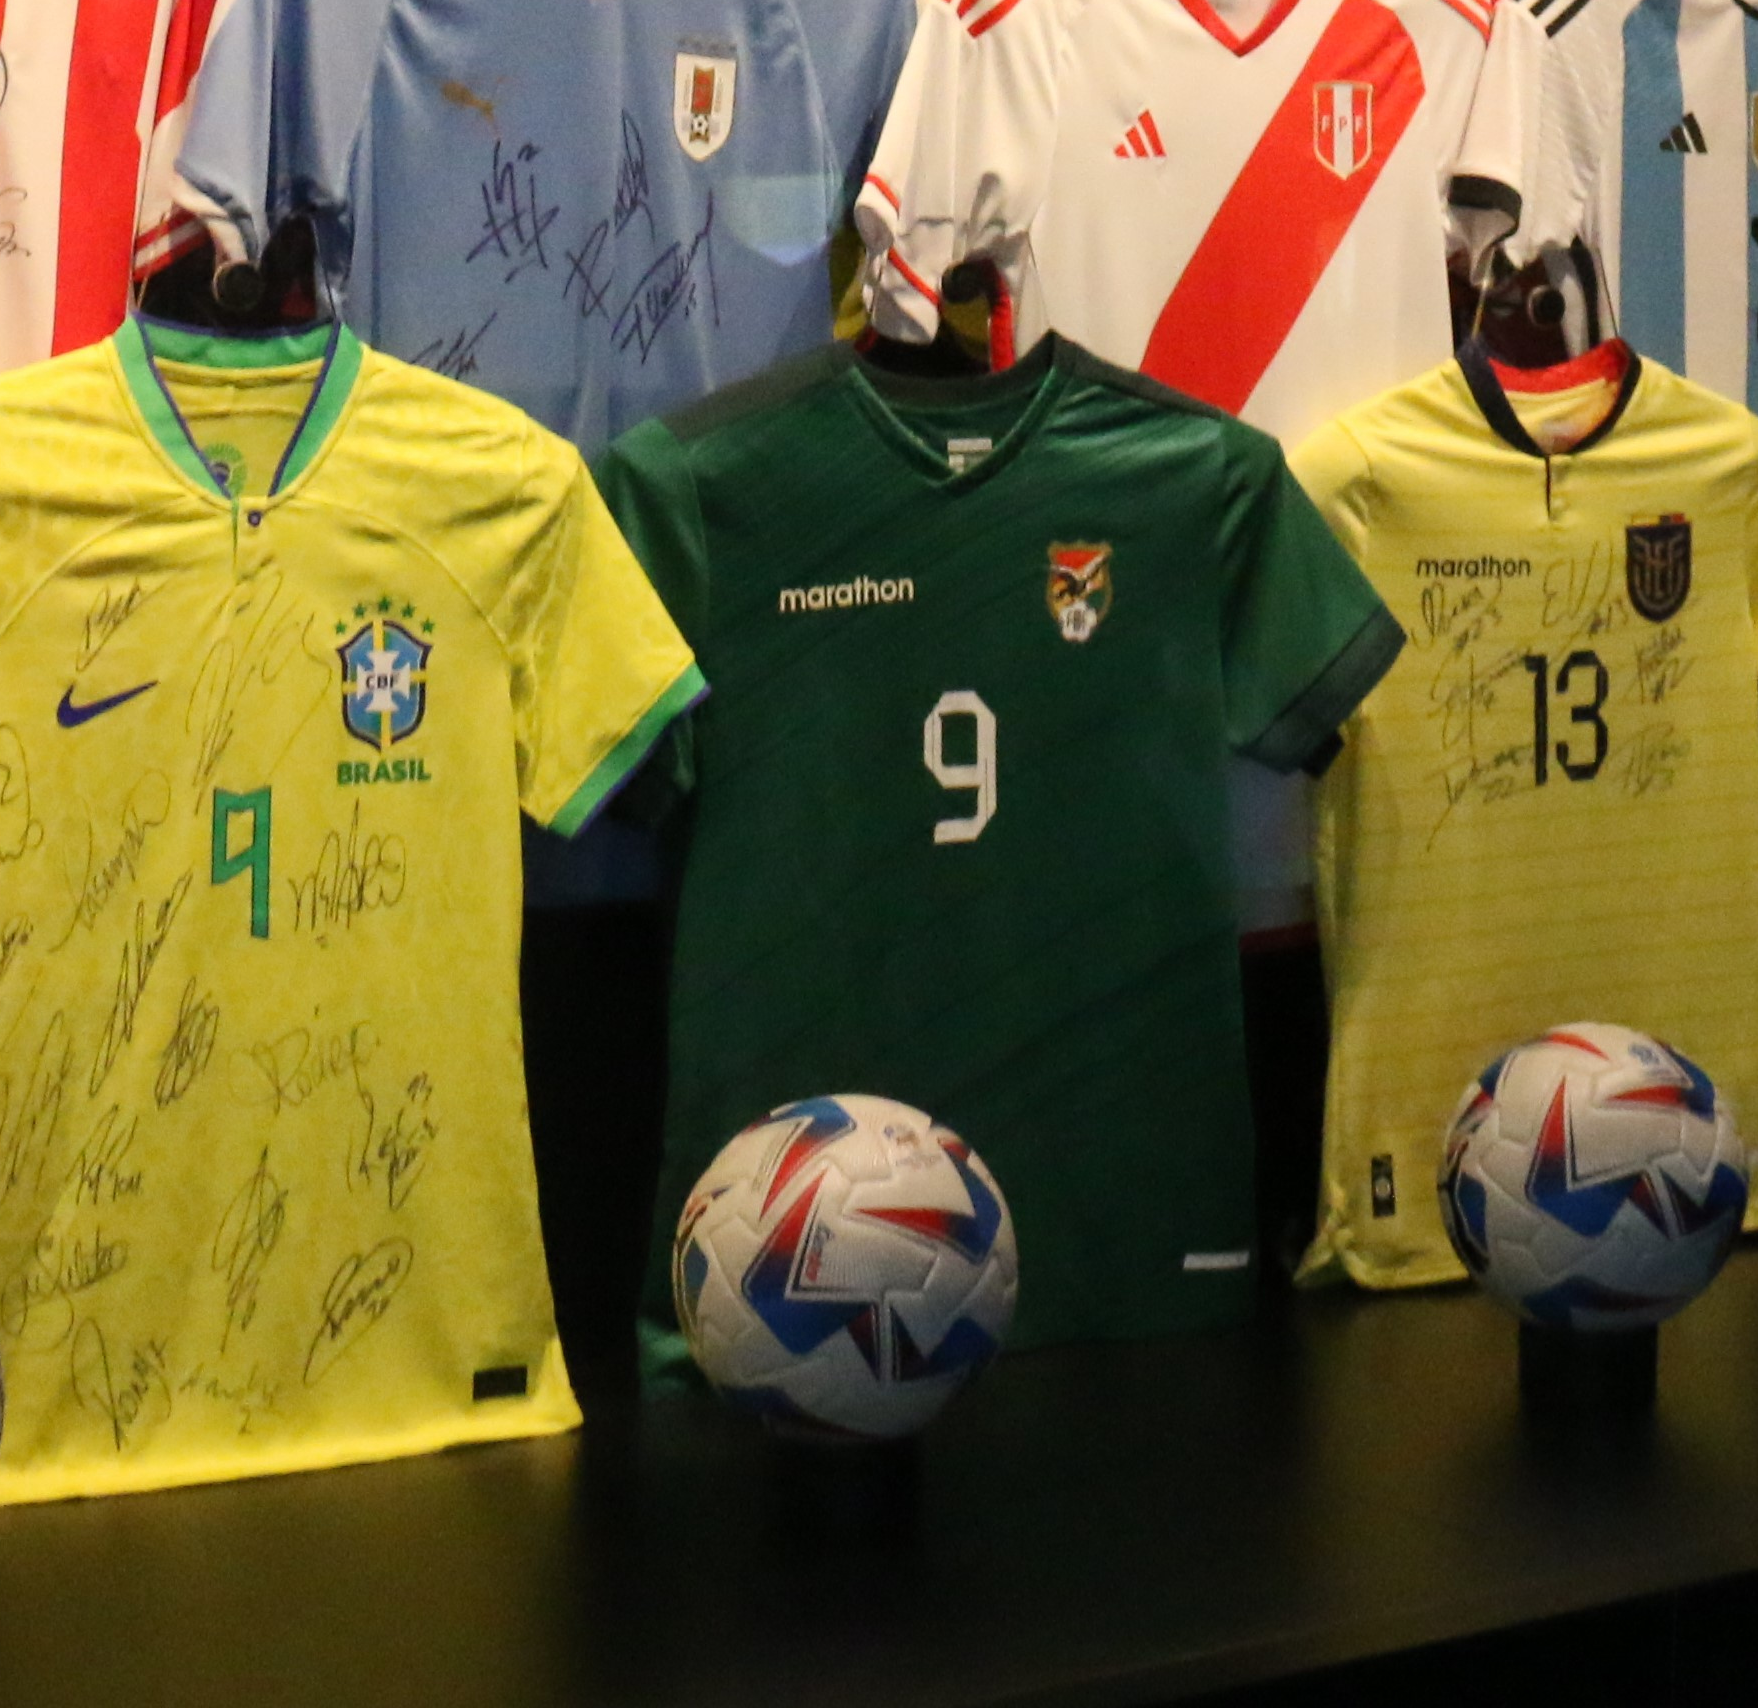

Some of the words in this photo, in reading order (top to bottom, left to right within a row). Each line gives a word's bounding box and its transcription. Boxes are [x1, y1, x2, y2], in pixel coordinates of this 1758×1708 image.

[1321, 115, 1364, 133] FPF
[1416, 556, 1531, 578] marathon
[779, 574, 914, 613] marathon
[366, 673, 399, 689] CBF
[1525, 649, 1609, 786] 13
[337, 759, 432, 785] BRASIL
[923, 690, 997, 844] 9
[212, 786, 272, 939] 9
